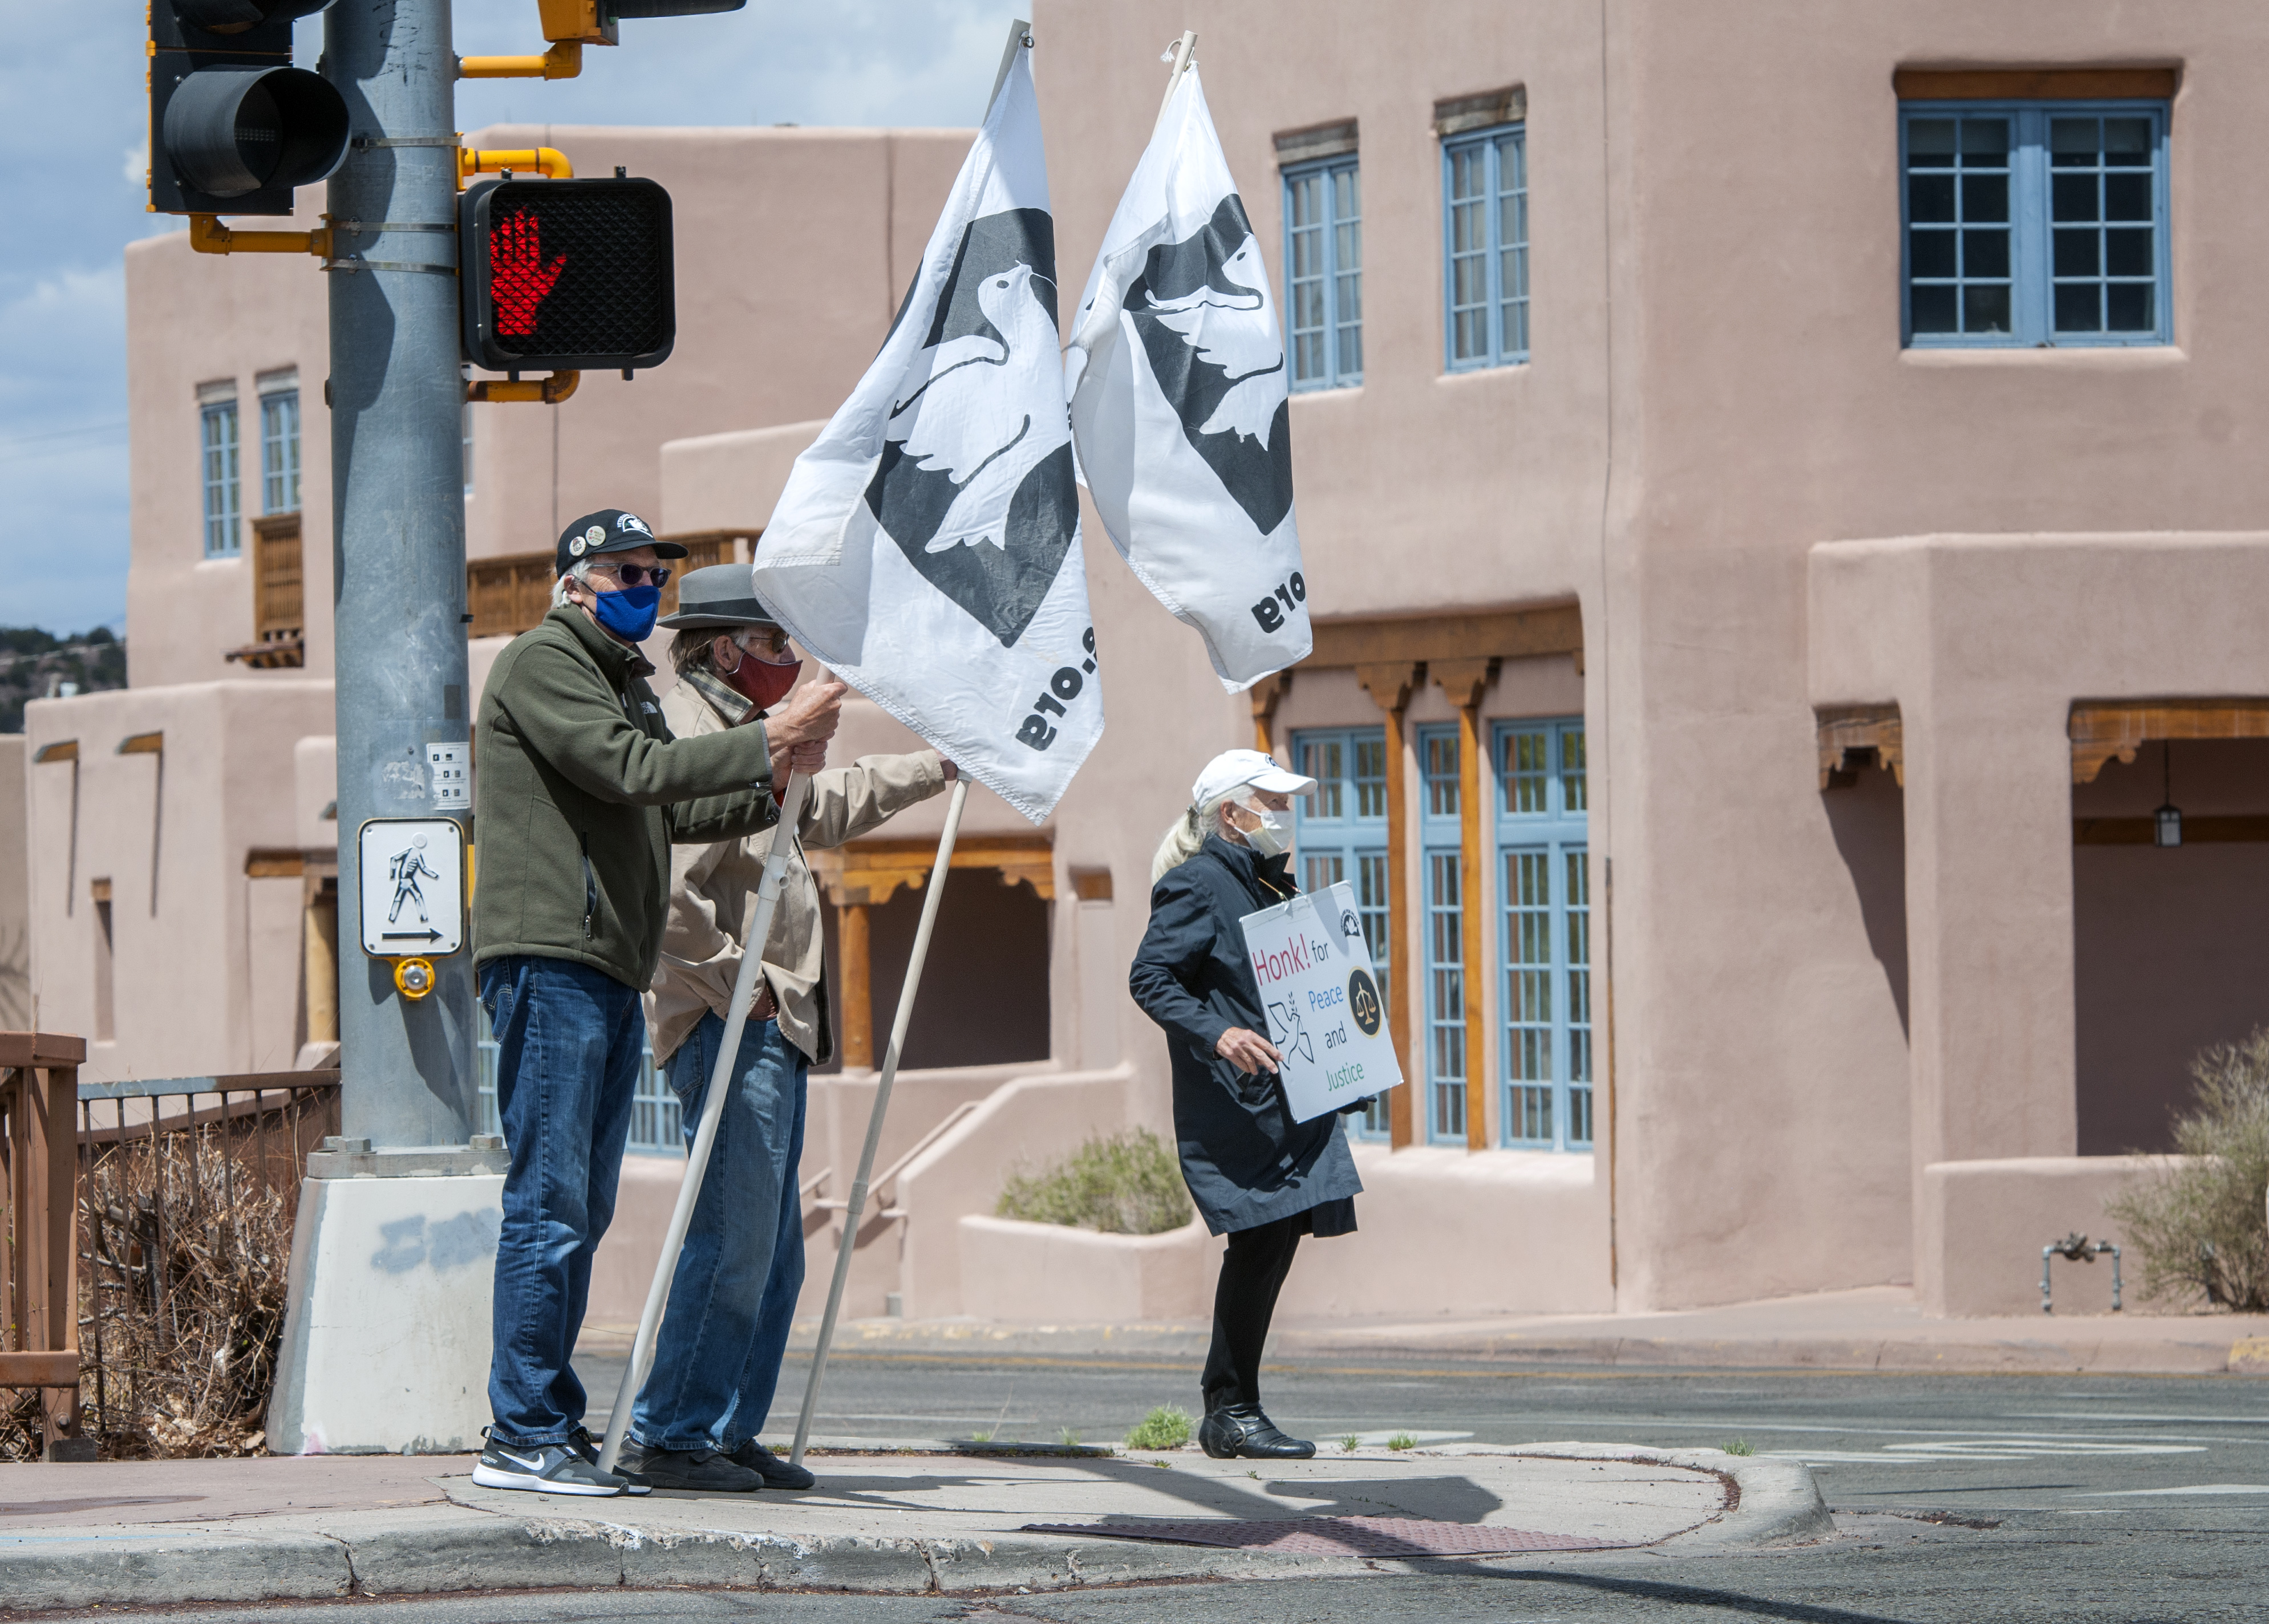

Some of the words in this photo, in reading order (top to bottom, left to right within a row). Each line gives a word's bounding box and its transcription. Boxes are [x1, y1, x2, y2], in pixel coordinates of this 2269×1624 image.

[1252, 933, 1311, 986] Honk!
[1311, 940, 1329, 963] for
[1308, 986, 1344, 1013] Peace
[1324, 1020, 1347, 1049] and
[1326, 1062, 1364, 1092] Justice
